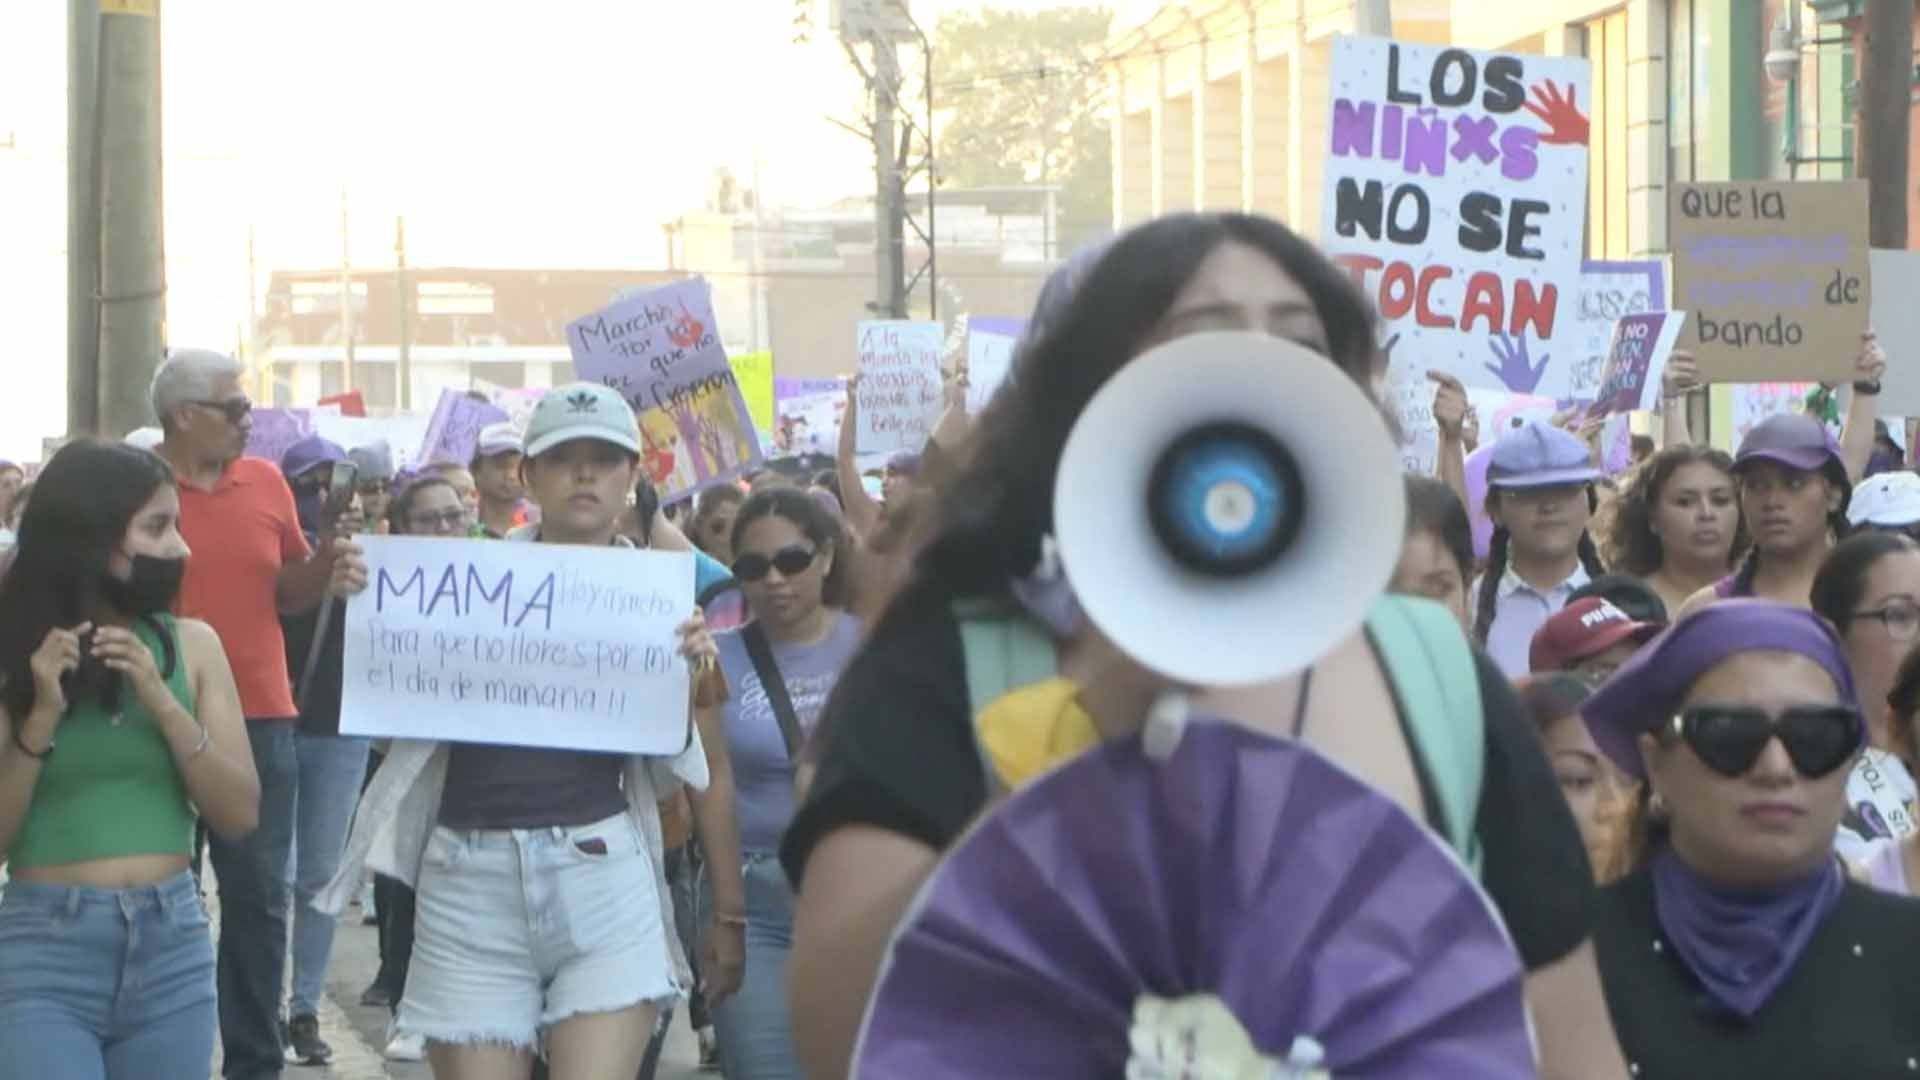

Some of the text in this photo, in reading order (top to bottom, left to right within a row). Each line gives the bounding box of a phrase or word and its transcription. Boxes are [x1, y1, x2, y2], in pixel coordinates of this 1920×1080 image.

[1387, 43, 1526, 114] LOS
[1331, 98, 1540, 181] NIÑXS
[1335, 176, 1551, 261] NO SE
[1680, 187, 1785, 220] Que la
[1332, 253, 1558, 340] TOCAN
[1825, 268, 1860, 305] de
[649, 348, 687, 377] que
[694, 333, 714, 353] no
[1697, 310, 1804, 349] bando
[375, 562, 557, 631] MAMA
[366, 617, 420, 658] Para
[432, 629, 467, 669] que
[473, 632, 504, 663] no
[509, 630, 588, 671] llores
[596, 640, 635, 677] por
[367, 659, 395, 692] el
[450, 671, 473, 700] de
